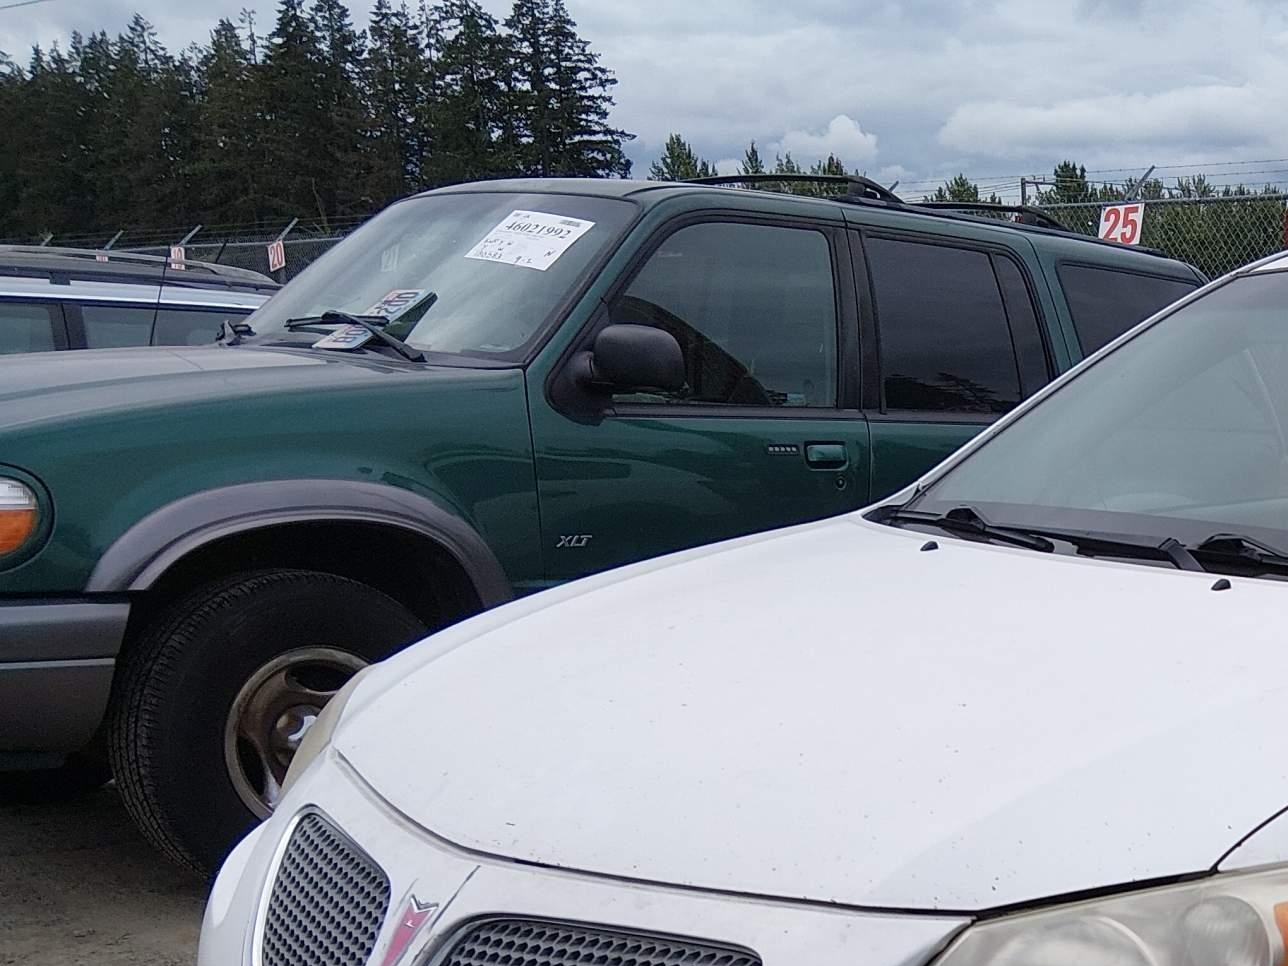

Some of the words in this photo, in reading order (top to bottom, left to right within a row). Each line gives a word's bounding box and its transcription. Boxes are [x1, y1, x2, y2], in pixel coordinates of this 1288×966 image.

[505, 221, 572, 239] 46021992
[1103, 206, 1140, 245] 25
[270, 242, 284, 269] 20
[556, 534, 593, 548] XLT
